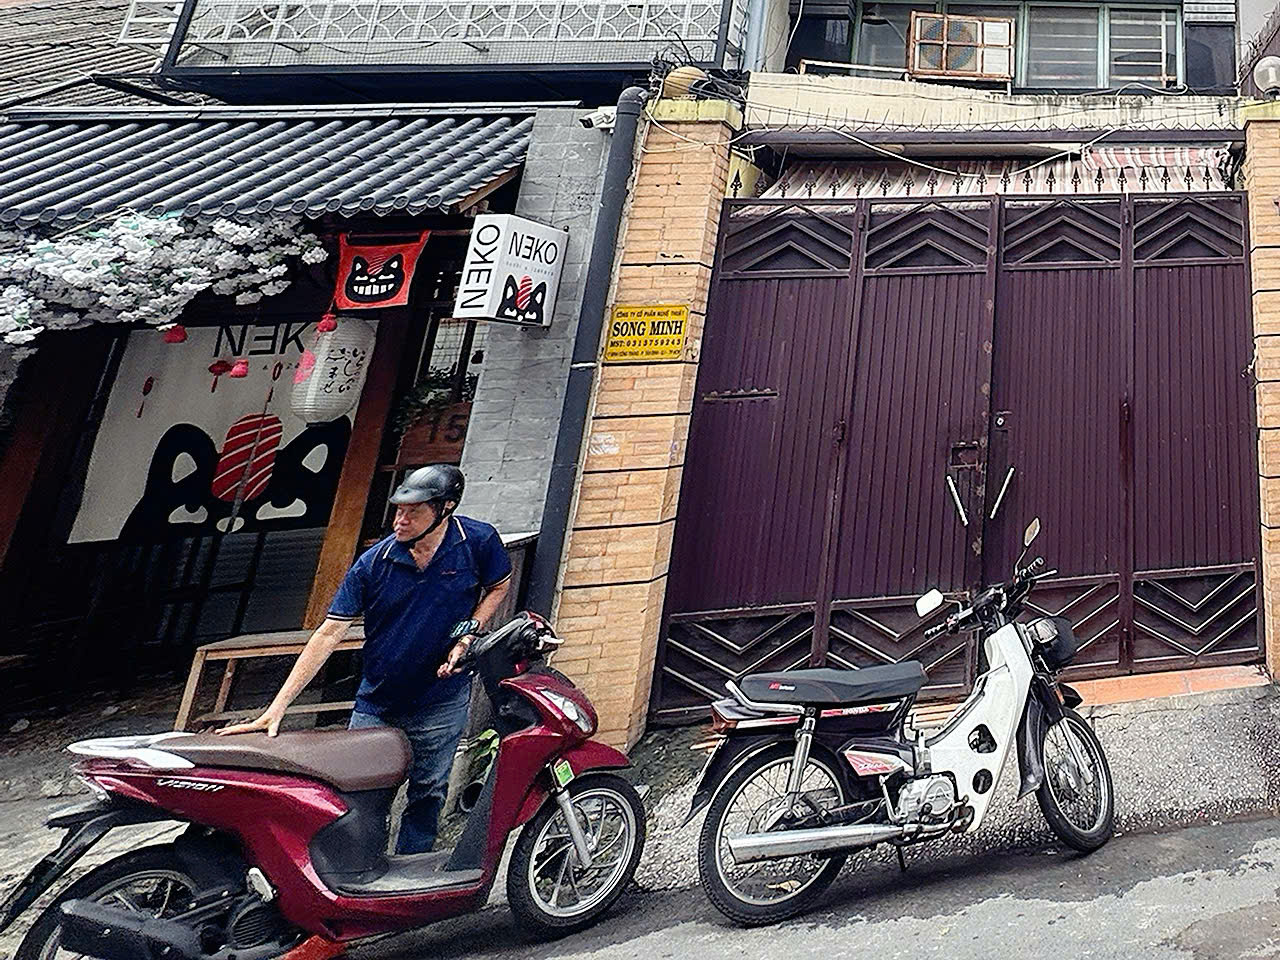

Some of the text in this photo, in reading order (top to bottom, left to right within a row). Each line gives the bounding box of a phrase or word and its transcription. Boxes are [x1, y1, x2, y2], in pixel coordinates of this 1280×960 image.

[508, 231, 558, 265] NEKO
[460, 224, 500, 309] NEKO
[612, 320, 684, 337] SONG MINH
